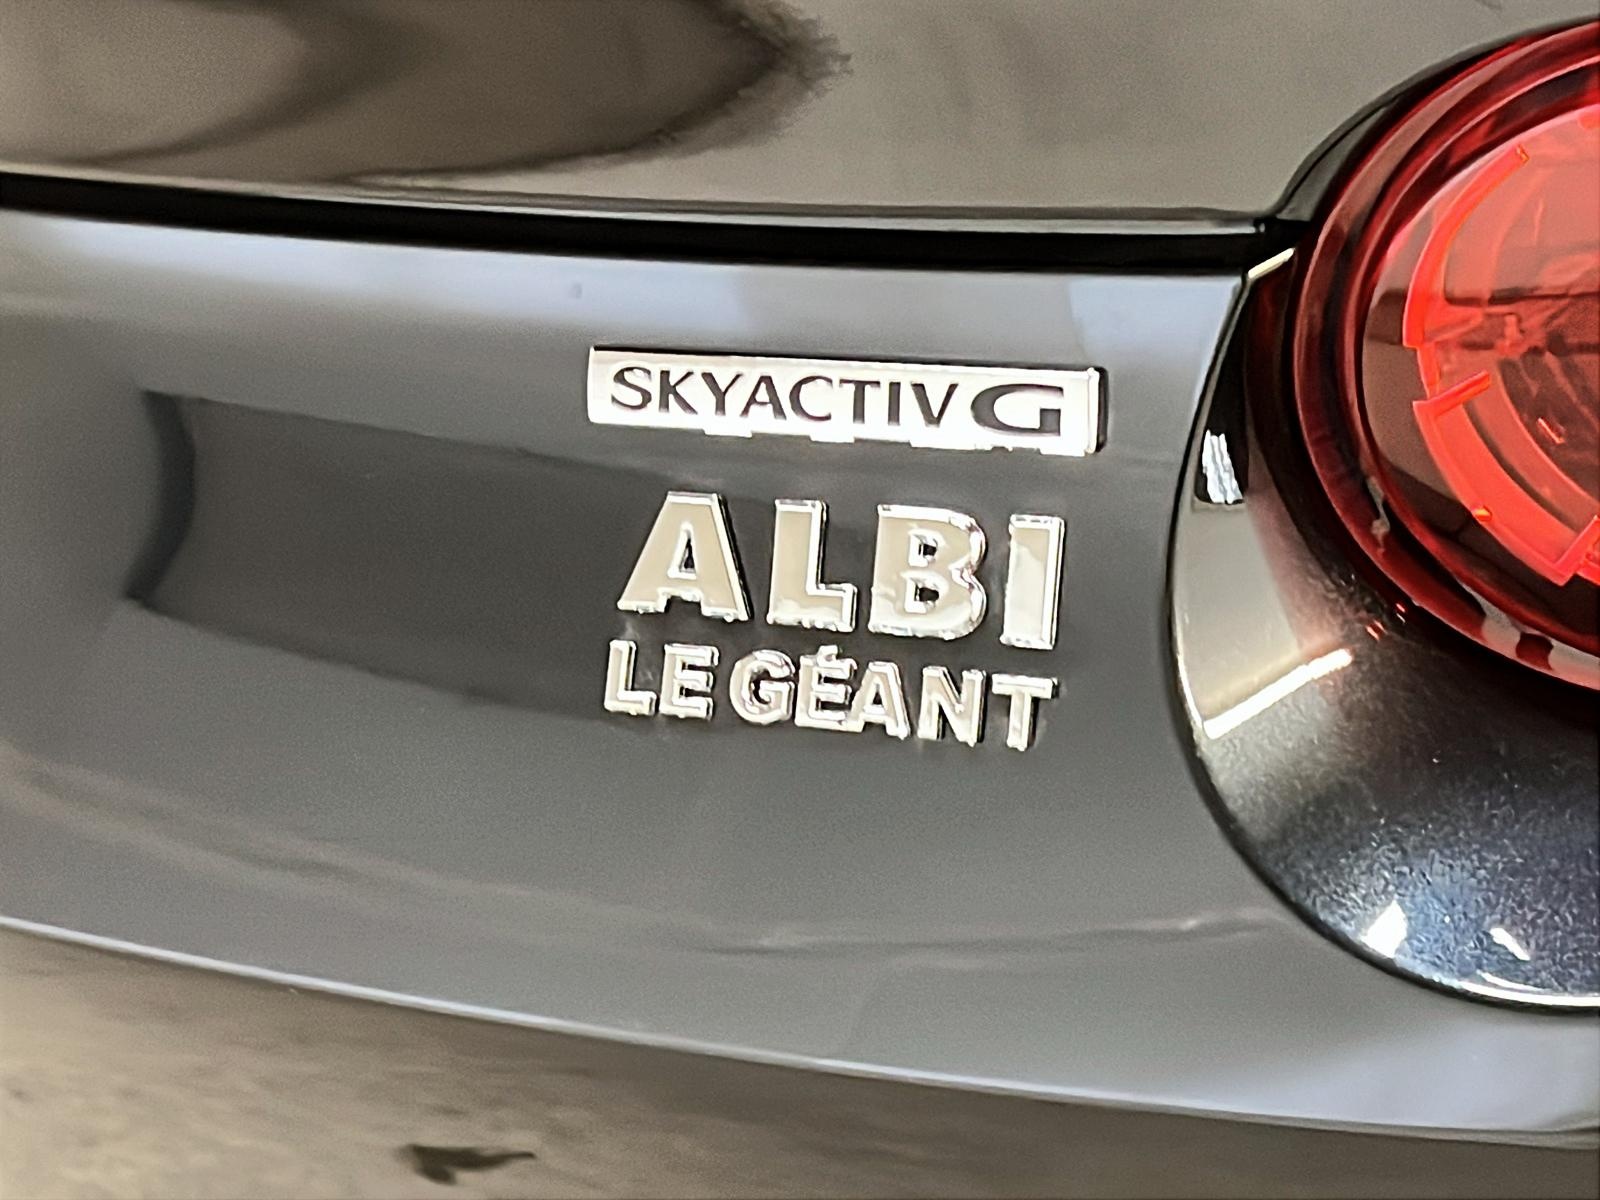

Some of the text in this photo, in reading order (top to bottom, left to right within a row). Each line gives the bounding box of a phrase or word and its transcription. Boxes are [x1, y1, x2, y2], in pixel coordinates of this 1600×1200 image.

[611, 366, 1064, 437] SKYACTIV G
[617, 491, 1065, 650] ALBI
[603, 640, 1057, 750] LE GÉANT
